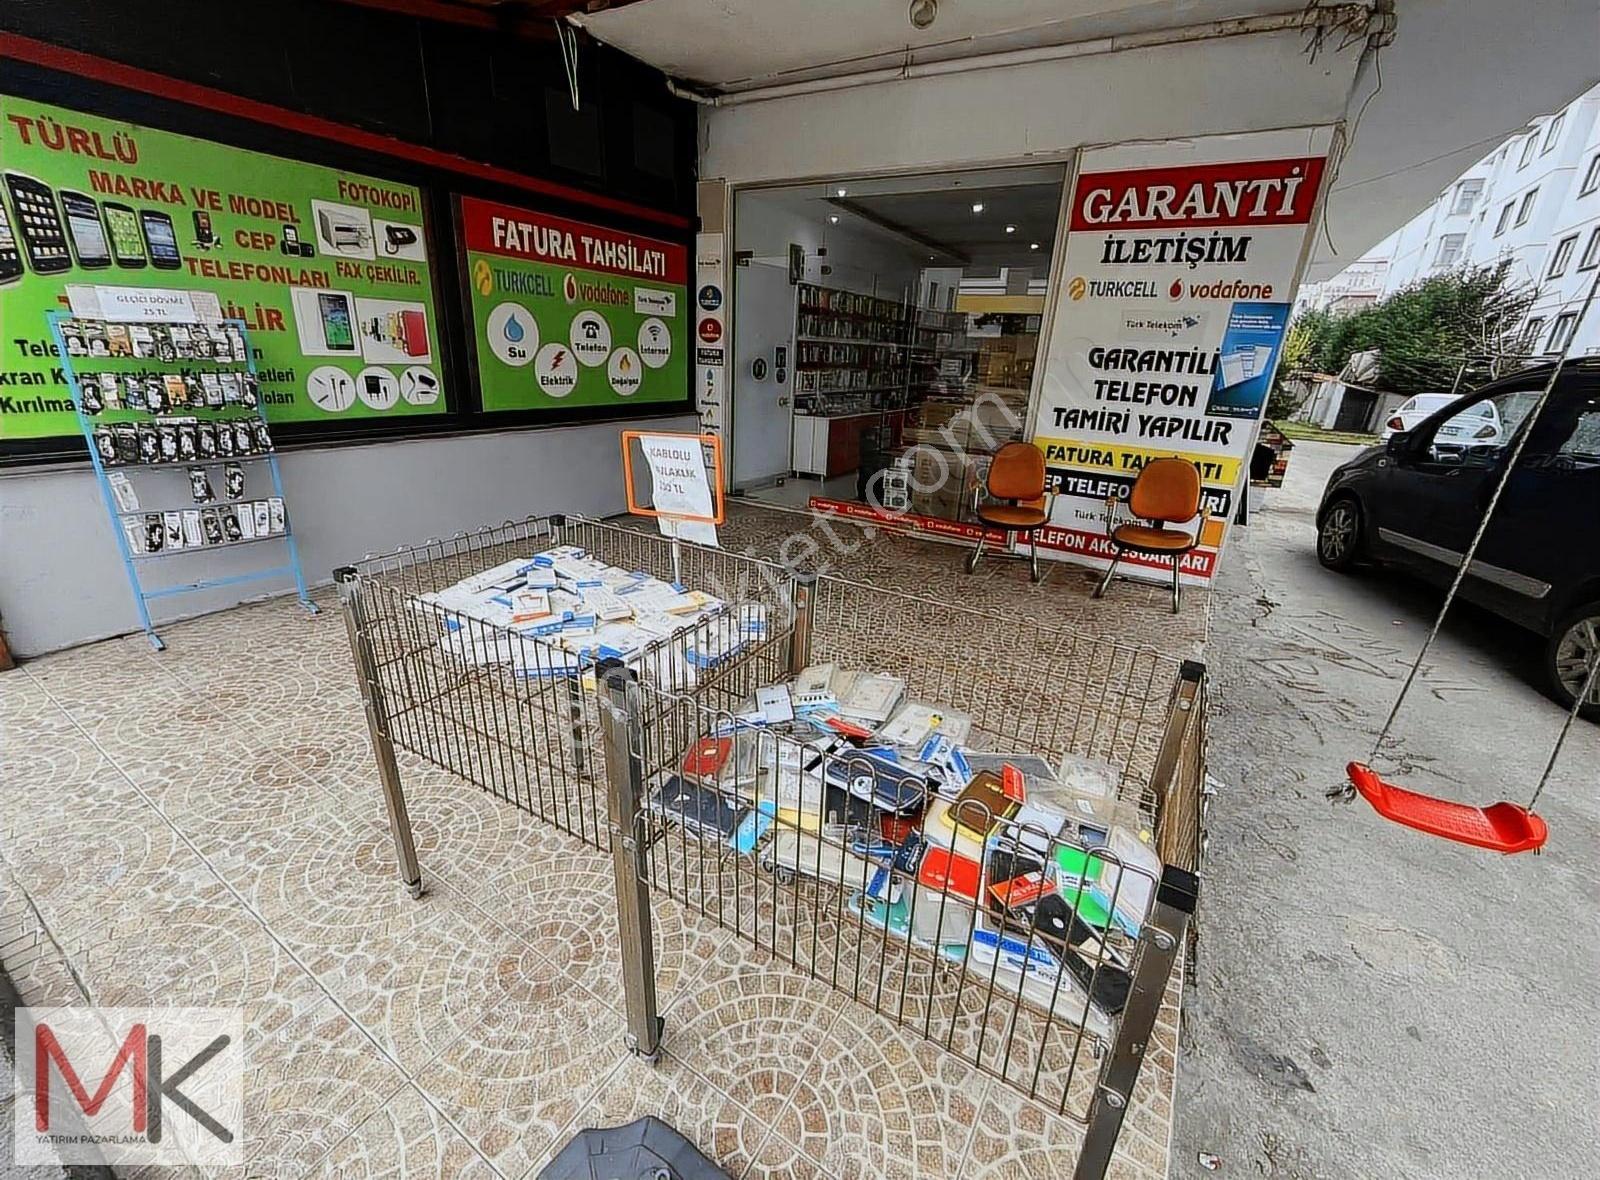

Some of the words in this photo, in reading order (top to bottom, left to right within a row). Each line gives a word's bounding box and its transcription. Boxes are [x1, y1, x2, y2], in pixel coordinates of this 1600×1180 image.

[7, 113, 138, 165] TÜRLÜ
[88, 170, 187, 205] MARKA
[190, 186, 223, 211] VE
[229, 193, 301, 224] MODEL
[338, 179, 418, 213] FOTOKOPİ
[1082, 166, 1303, 224] GARANTİ
[234, 229, 277, 251] CEP
[492, 216, 577, 261] FATURA
[581, 235, 666, 277] TAHSİLATI
[1100, 230, 1252, 269] İLETİŞİM
[183, 256, 331, 288] TELEFONLARI
[336, 261, 363, 278] FAX
[494, 268, 555, 297] TURKCELL
[580, 281, 631, 306] vodafone
[1089, 279, 1158, 298] TURKCELL
[1189, 279, 1274, 300] vodafone
[508, 347, 526, 358] Su
[575, 343, 607, 352] Telefon
[1088, 346, 1220, 375] GARANTİLİ
[540, 376, 574, 386] Elektrik
[1094, 379, 1199, 406] TELEFON
[1053, 406, 1131, 433] TAMİRİ
[1137, 414, 1233, 446] YAPILIR
[1046, 444, 1114, 468] FATURA
[1044, 474, 1063, 489] EP
